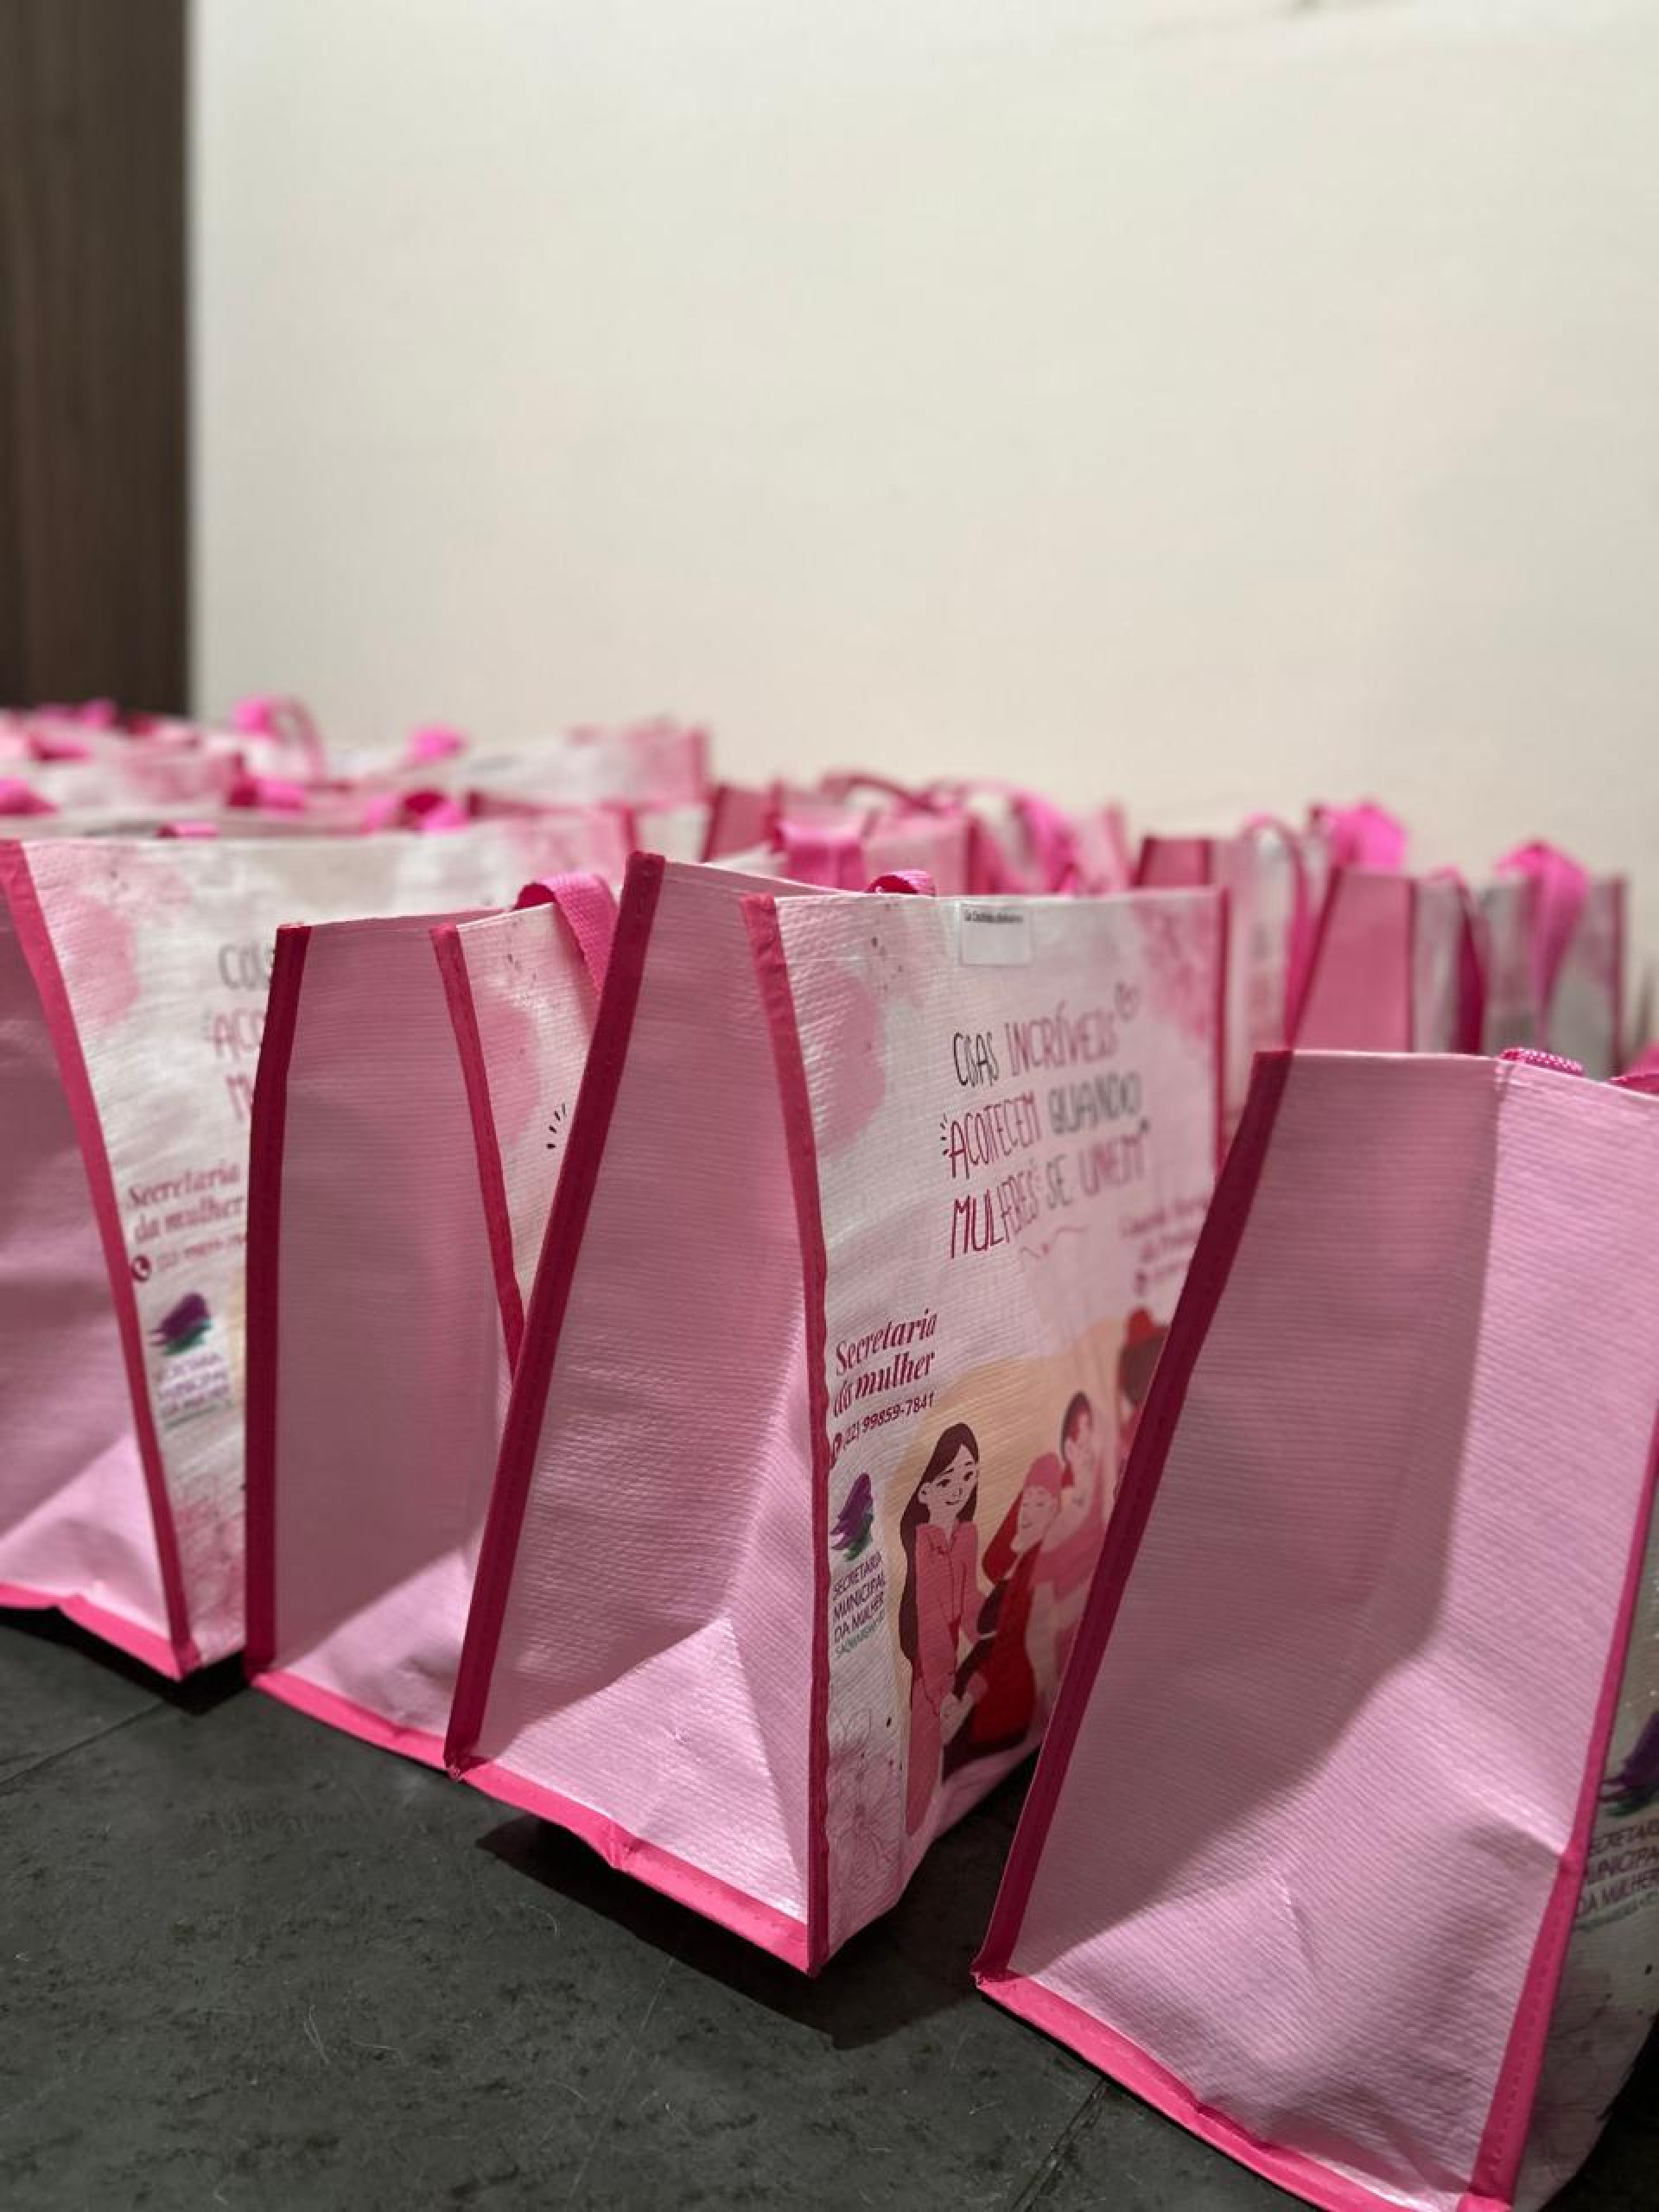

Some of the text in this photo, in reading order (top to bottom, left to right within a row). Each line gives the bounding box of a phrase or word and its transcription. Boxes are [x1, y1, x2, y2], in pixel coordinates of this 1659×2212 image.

[1048, 1071, 1143, 1135] QUANDO
[1046, 1154, 1073, 1209] SE
[836, 1308, 938, 1376] Secretaria
[855, 1351, 936, 1400] mulher
